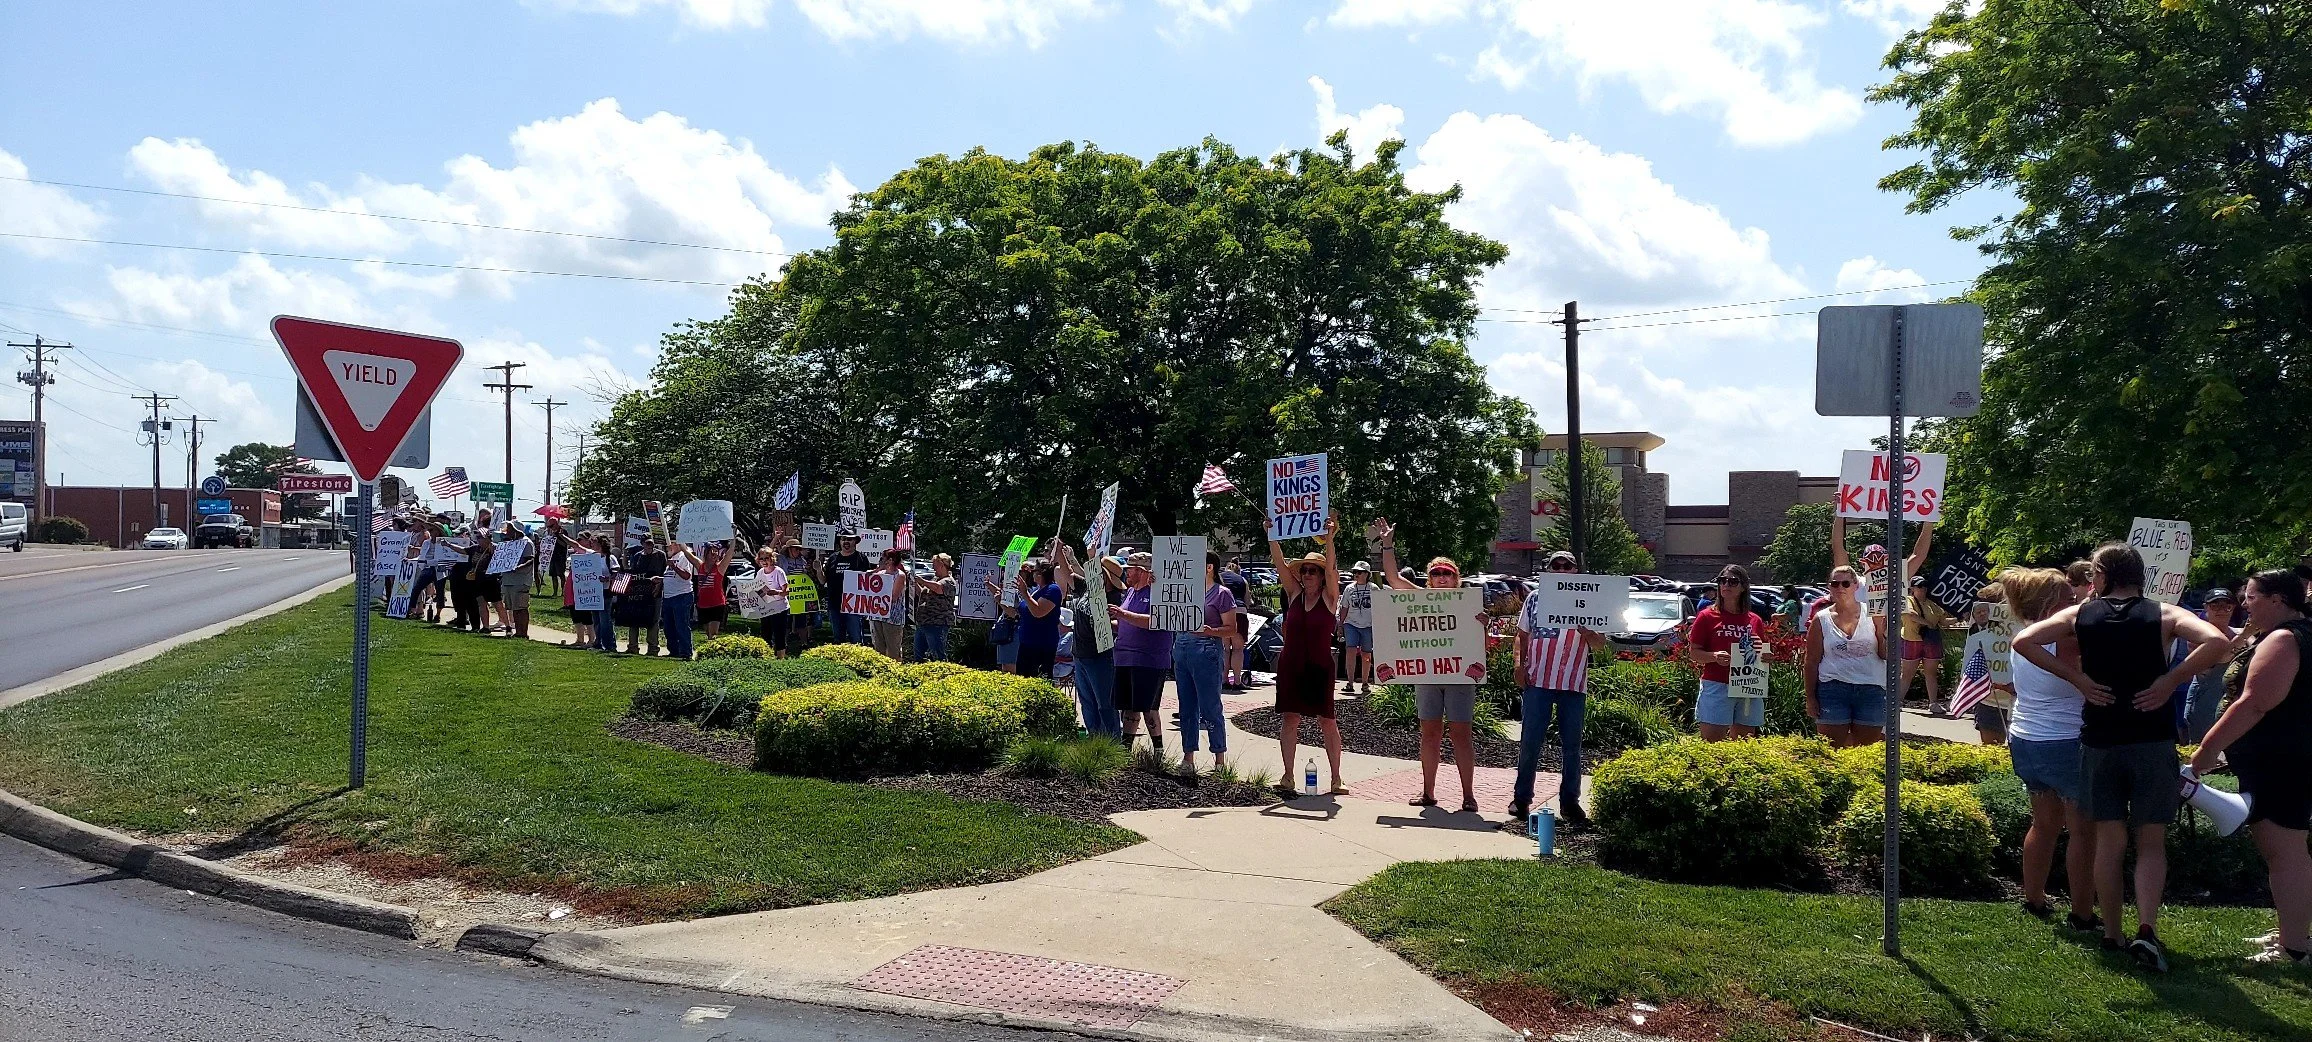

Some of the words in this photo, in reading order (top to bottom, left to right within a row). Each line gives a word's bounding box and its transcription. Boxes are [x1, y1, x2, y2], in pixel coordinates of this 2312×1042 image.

[342, 362, 397, 386] YIELD
[1273, 461, 1294, 479] NO
[280, 477, 350, 488] Firestone
[1273, 475, 1321, 496] KINGS
[1274, 493, 1322, 515] SINCE
[1840, 484, 1937, 516] KINGS
[633, 523, 650, 533] Supp
[1274, 511, 1322, 537] 1776
[1168, 536, 1188, 556] WE
[2131, 528, 2165, 548] BLUE
[2173, 530, 2191, 551] RED
[399, 561, 414, 580] NO
[968, 567, 995, 576] PEOPLE
[975, 560, 989, 568] ALL
[1163, 560, 1194, 580] HAVE
[1959, 553, 1989, 576] ISN'T
[857, 573, 884, 593] NO
[1870, 569, 1888, 581] NO
[1938, 564, 1986, 597] FREE
[2158, 571, 2186, 596] GREED
[968, 589, 991, 597] EQUAL
[1161, 583, 1194, 604] BEEN
[1557, 581, 1601, 592] DISSENT
[787, 592, 815, 601] OCRACY
[841, 592, 891, 617] KINGS
[1390, 593, 1416, 603] YOU
[1425, 591, 1464, 601] CAN'T
[1575, 599, 1586, 609] IS
[1930, 581, 1972, 613] DOM
[1150, 604, 1203, 631] BETRAYED
[1406, 604, 1445, 615] SPELL
[1397, 614, 1457, 633] HATRED
[1548, 614, 1609, 627] PATRIOTIC!
[1399, 638, 1455, 649] WITHOUT
[1716, 630, 1742, 639] TRU
[1395, 658, 1427, 676] RED
[1432, 656, 1463, 675] HAT
[1730, 665, 1752, 677] NO
